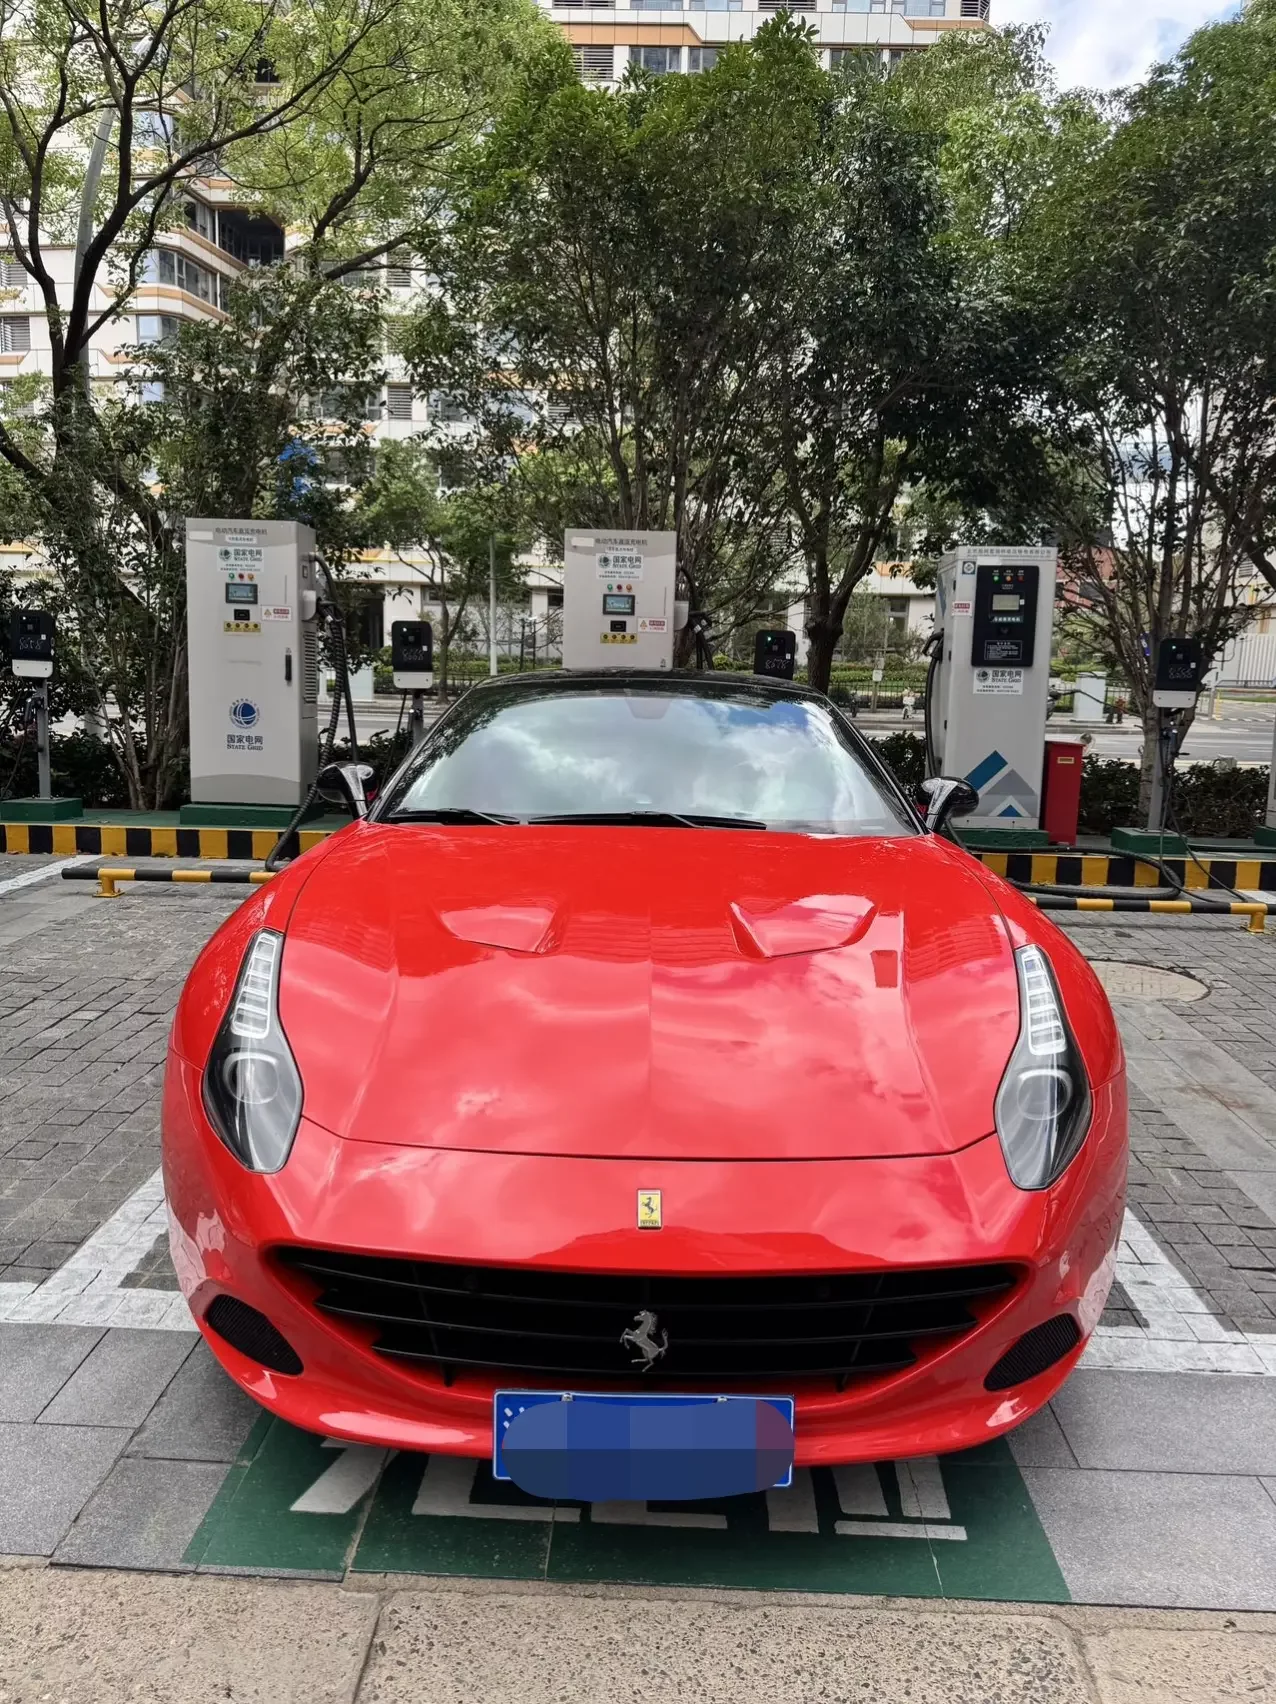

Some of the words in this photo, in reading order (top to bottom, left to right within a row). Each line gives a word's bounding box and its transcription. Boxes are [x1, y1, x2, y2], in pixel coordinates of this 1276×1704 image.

[233, 549, 262, 557] 国家电网
[612, 556, 642, 564] 国家电网
[991, 669, 1022, 678] 国家电网
[227, 734, 263, 745] 国家电网
